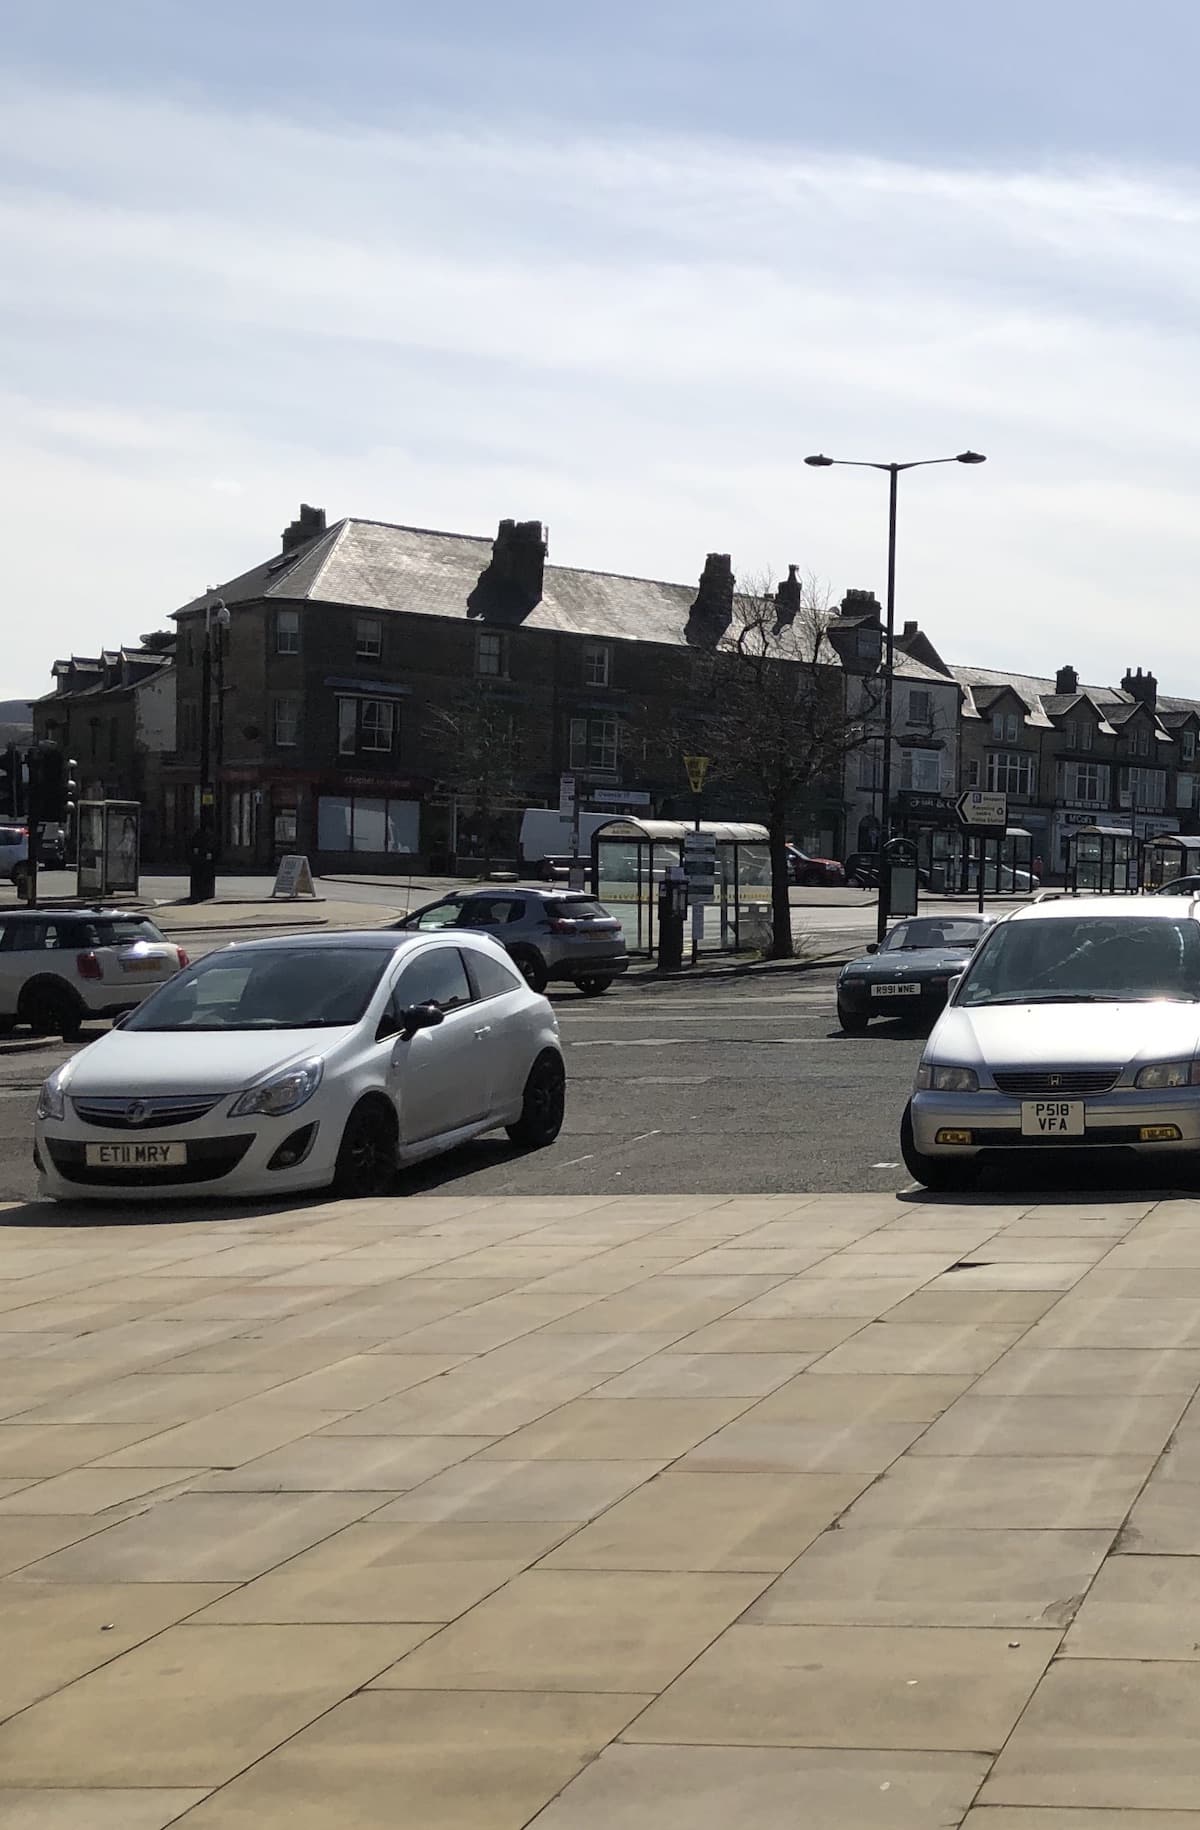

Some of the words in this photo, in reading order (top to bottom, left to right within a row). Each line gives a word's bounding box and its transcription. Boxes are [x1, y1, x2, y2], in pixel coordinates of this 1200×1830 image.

[876, 985, 896, 994] R991
[898, 984, 915, 993] WNE
[1036, 1103, 1069, 1116] P518
[1038, 1118, 1067, 1131] VFA
[100, 1146, 130, 1162] ET11
[135, 1146, 170, 1162] MRY
